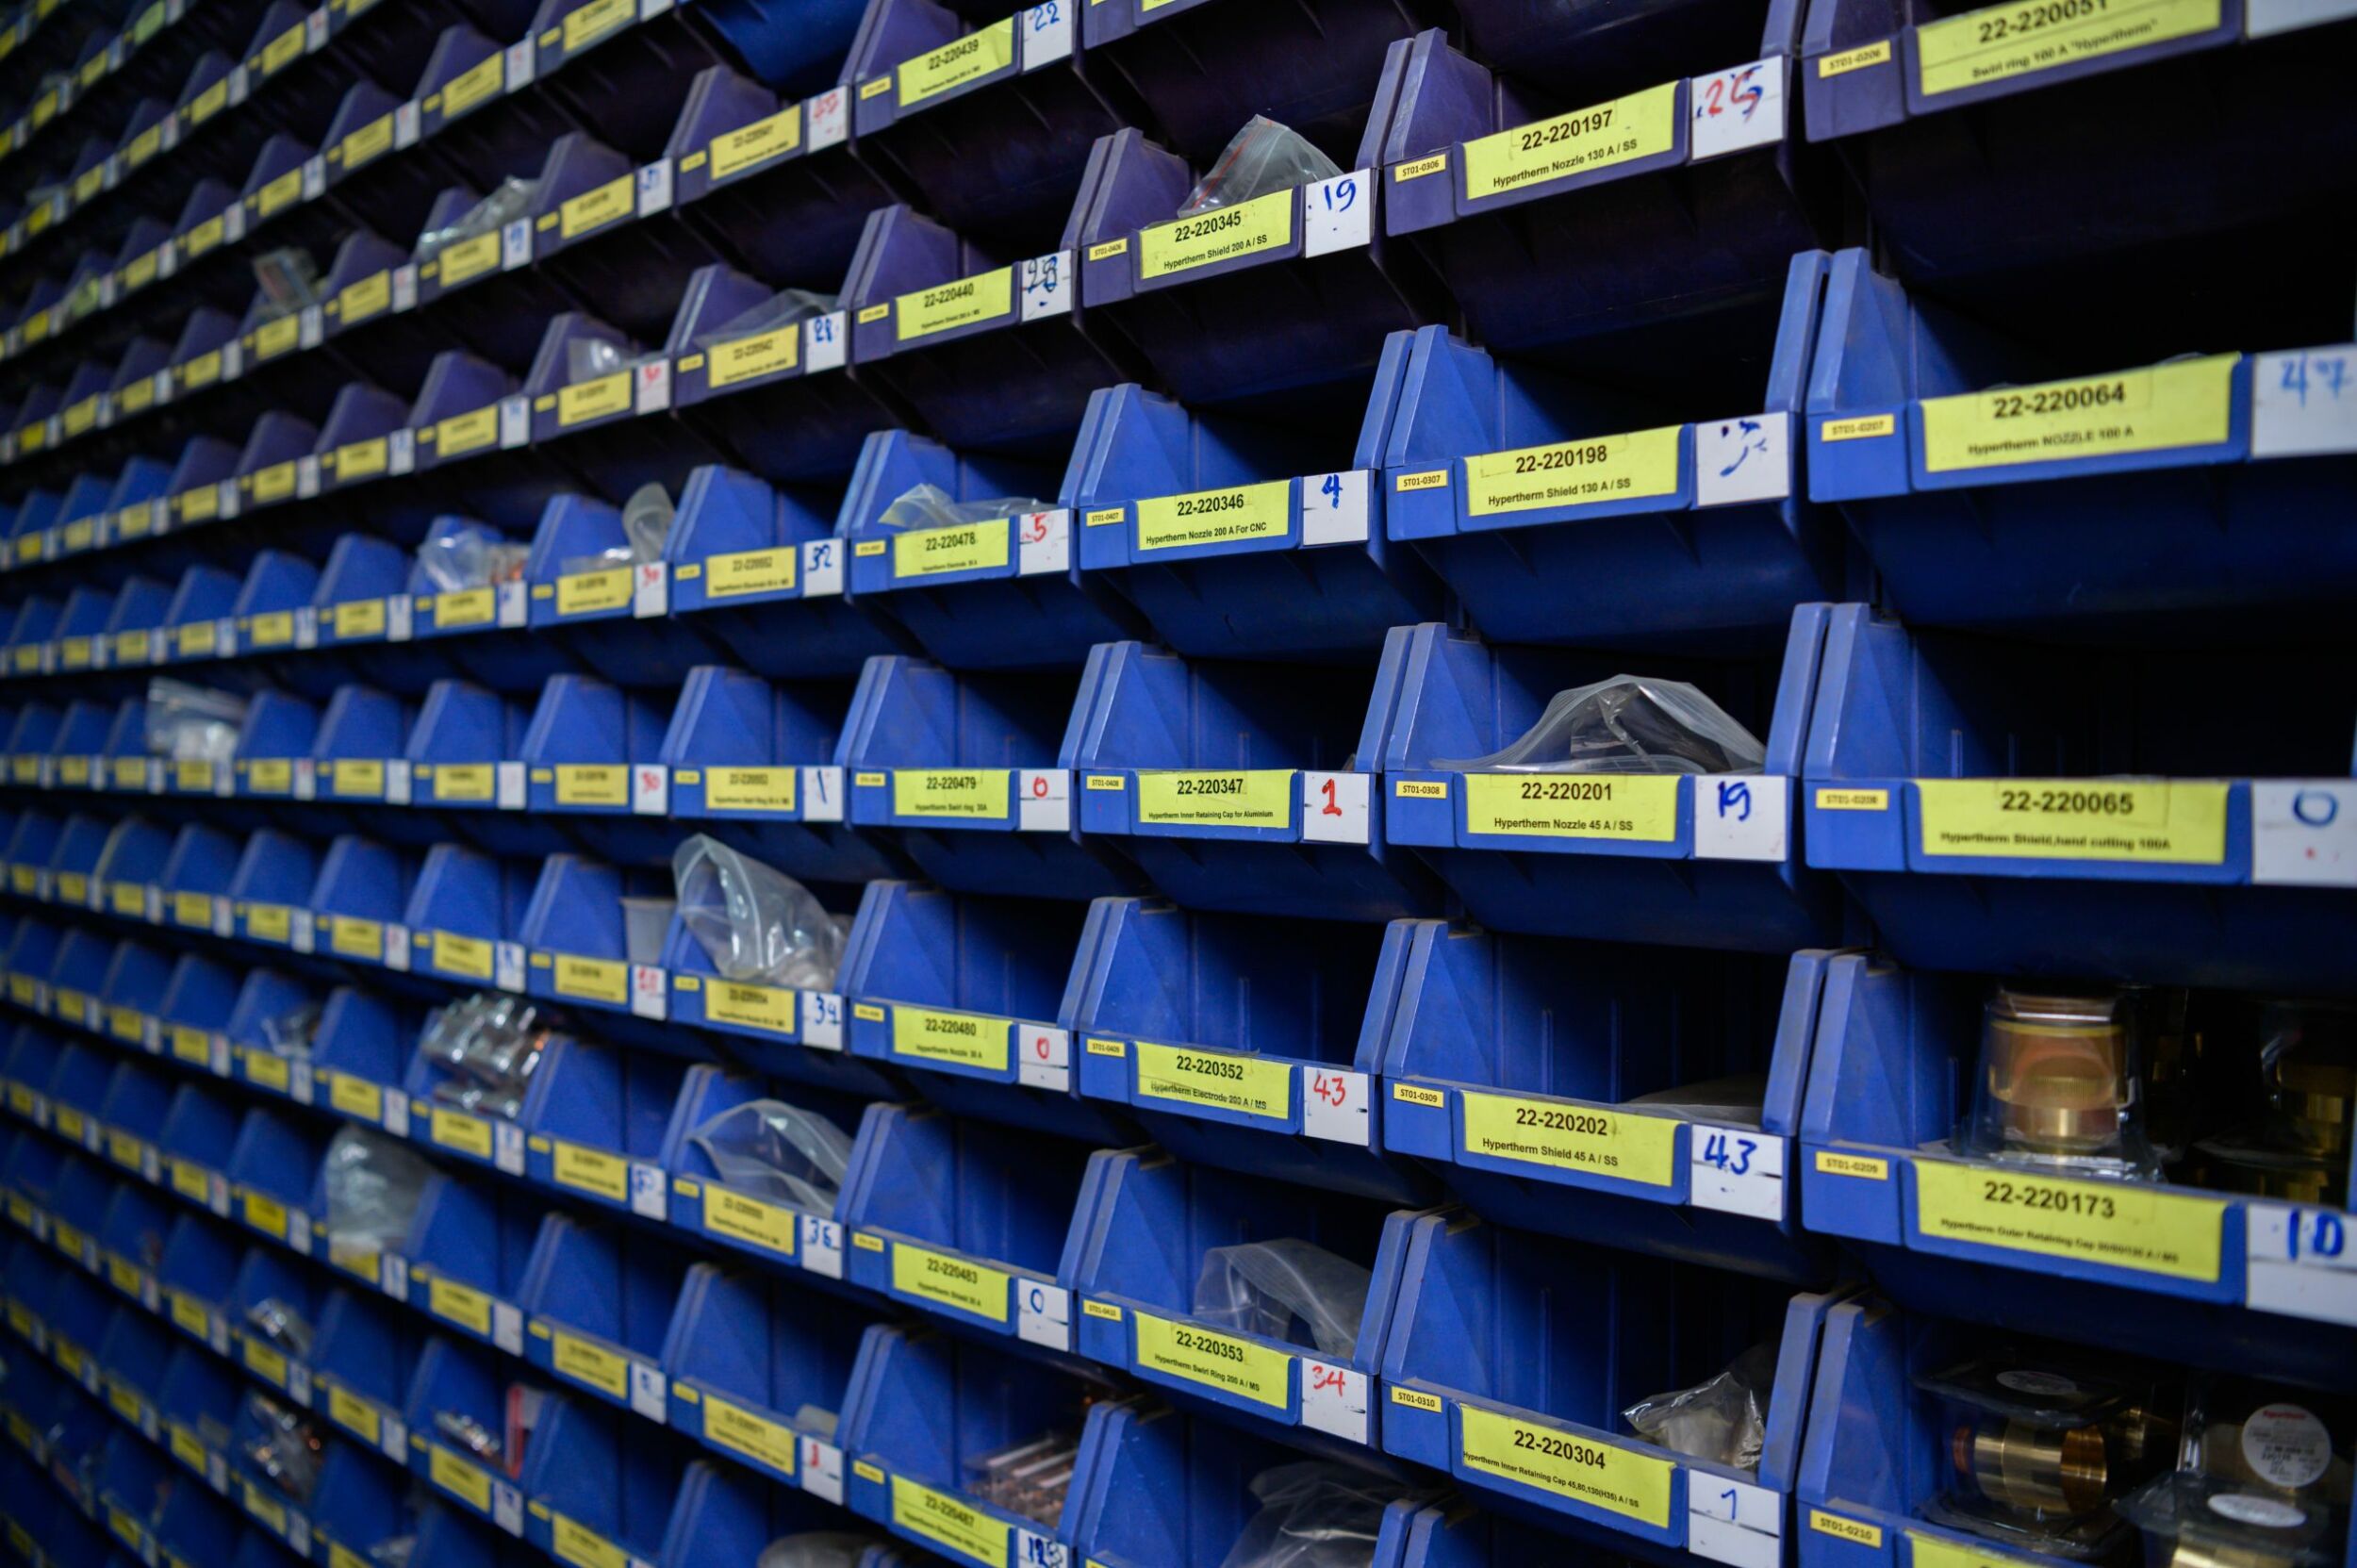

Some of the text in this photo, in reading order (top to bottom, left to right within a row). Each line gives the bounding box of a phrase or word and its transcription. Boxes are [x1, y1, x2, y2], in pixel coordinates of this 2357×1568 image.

[1033, 2, 1060, 30] 22
[1972, 64, 2003, 79] Swirl
[2005, 58, 2030, 74] ring
[2057, 46, 2068, 57] A
[1522, 110, 1612, 152] 22-220197
[1402, 160, 1440, 176] ST01-0306
[1493, 166, 1549, 188] Hypertherm
[1552, 155, 1585, 173] Nozzle
[1587, 148, 1605, 163] 130
[1606, 145, 1615, 157] A
[1623, 140, 1637, 152] SS
[1324, 178, 1357, 213] 19
[1175, 210, 1241, 243] 22-220345
[1163, 253, 1206, 270] Hypertherm
[1207, 246, 1230, 259] Shield
[1231, 240, 1244, 252] 200
[1244, 239, 1251, 248] A
[1257, 234, 1267, 245] SS
[924, 283, 974, 308] 22-220440
[1992, 382, 2125, 420] 22-220064
[1969, 437, 2039, 454] Hypertherm
[2099, 428, 2121, 440] 100
[2124, 426, 2134, 437] A
[1515, 445, 1607, 474] 22-220198
[1403, 475, 1441, 487] ST01-0307
[1489, 488, 1544, 507] Hypertherm
[1547, 485, 1578, 497] Shield
[1581, 482, 1598, 494] 130
[1600, 480, 1609, 491] A
[1616, 477, 1631, 489] SS
[1177, 494, 1244, 517] 22-220346
[925, 532, 976, 551] 22-220478
[1030, 513, 1048, 542] 5
[1146, 521, 1267, 545] Hypertherm Nozzle 200 A For CNC
[927, 776, 976, 790] 22-220479
[1033, 776, 1047, 798] 0
[1177, 779, 1243, 795] 22-220347
[1403, 784, 1441, 795] ST01-0308
[1522, 782, 1612, 801] 22-220201
[1322, 779, 1343, 817] 1
[2001, 790, 2134, 816] 22-220065
[1148, 811, 1178, 820] Hypertherm
[1180, 811, 1195, 819] Inner
[1195, 811, 1222, 820] Retaining
[1223, 812, 1233, 820] Cap
[1494, 817, 1551, 832] Hypertherm
[1553, 819, 1586, 830] Nozzle
[1589, 819, 1601, 830] 45
[1603, 819, 1612, 830] A
[1619, 820, 1633, 832] SS
[1940, 832, 2010, 844] Hypertherm
[2090, 837, 2134, 850] cutting
[925, 1018, 976, 1036] 22-220480
[1177, 1055, 1244, 1081] 22-220352
[1150, 1081, 1192, 1098] Hypertherm
[1193, 1088, 1228, 1103] Electrode
[1243, 1097, 1249, 1107] A
[1255, 1100, 1267, 1110] MS
[1313, 1074, 1346, 1107] 43
[1400, 1088, 1438, 1103] ST01-0309
[1516, 1108, 1607, 1136] 22-220202
[1482, 1138, 1539, 1158] Hypertherm
[1541, 1146, 1572, 1161] Shield
[1574, 1150, 1586, 1161] 45
[1588, 1152, 1596, 1163] A
[1604, 1155, 1618, 1166] SS
[1704, 1134, 1757, 1175] 43
[1985, 1180, 2115, 1219] 22-220173
[1940, 1217, 1995, 1233] Hypertherm
[2026, 1230, 2072, 1247] Retaining
[927, 1258, 978, 1284] 22-220483
[1030, 1288, 1045, 1314] 0
[1177, 1330, 1244, 1362] 22-220353
[1154, 1354, 1192, 1371] Hypertherm
[1193, 1363, 1209, 1376] Swirl
[1211, 1368, 1226, 1382] Ring
[1227, 1374, 1238, 1385] 200
[1239, 1378, 1244, 1388] A
[1249, 1381, 1260, 1393] MS
[1312, 1365, 1346, 1397] 34
[1398, 1392, 1435, 1408] ST01-0310
[1514, 1430, 1606, 1470] 22-220304
[1463, 1452, 1499, 1467] Hypertherm
[1501, 1461, 1518, 1472] Inner
[1519, 1466, 1551, 1482] Retaining
[1553, 1476, 1566, 1486] Cap
[1629, 1499, 1639, 1508] SS
[1820, 1517, 1872, 1541] ST01-0210
